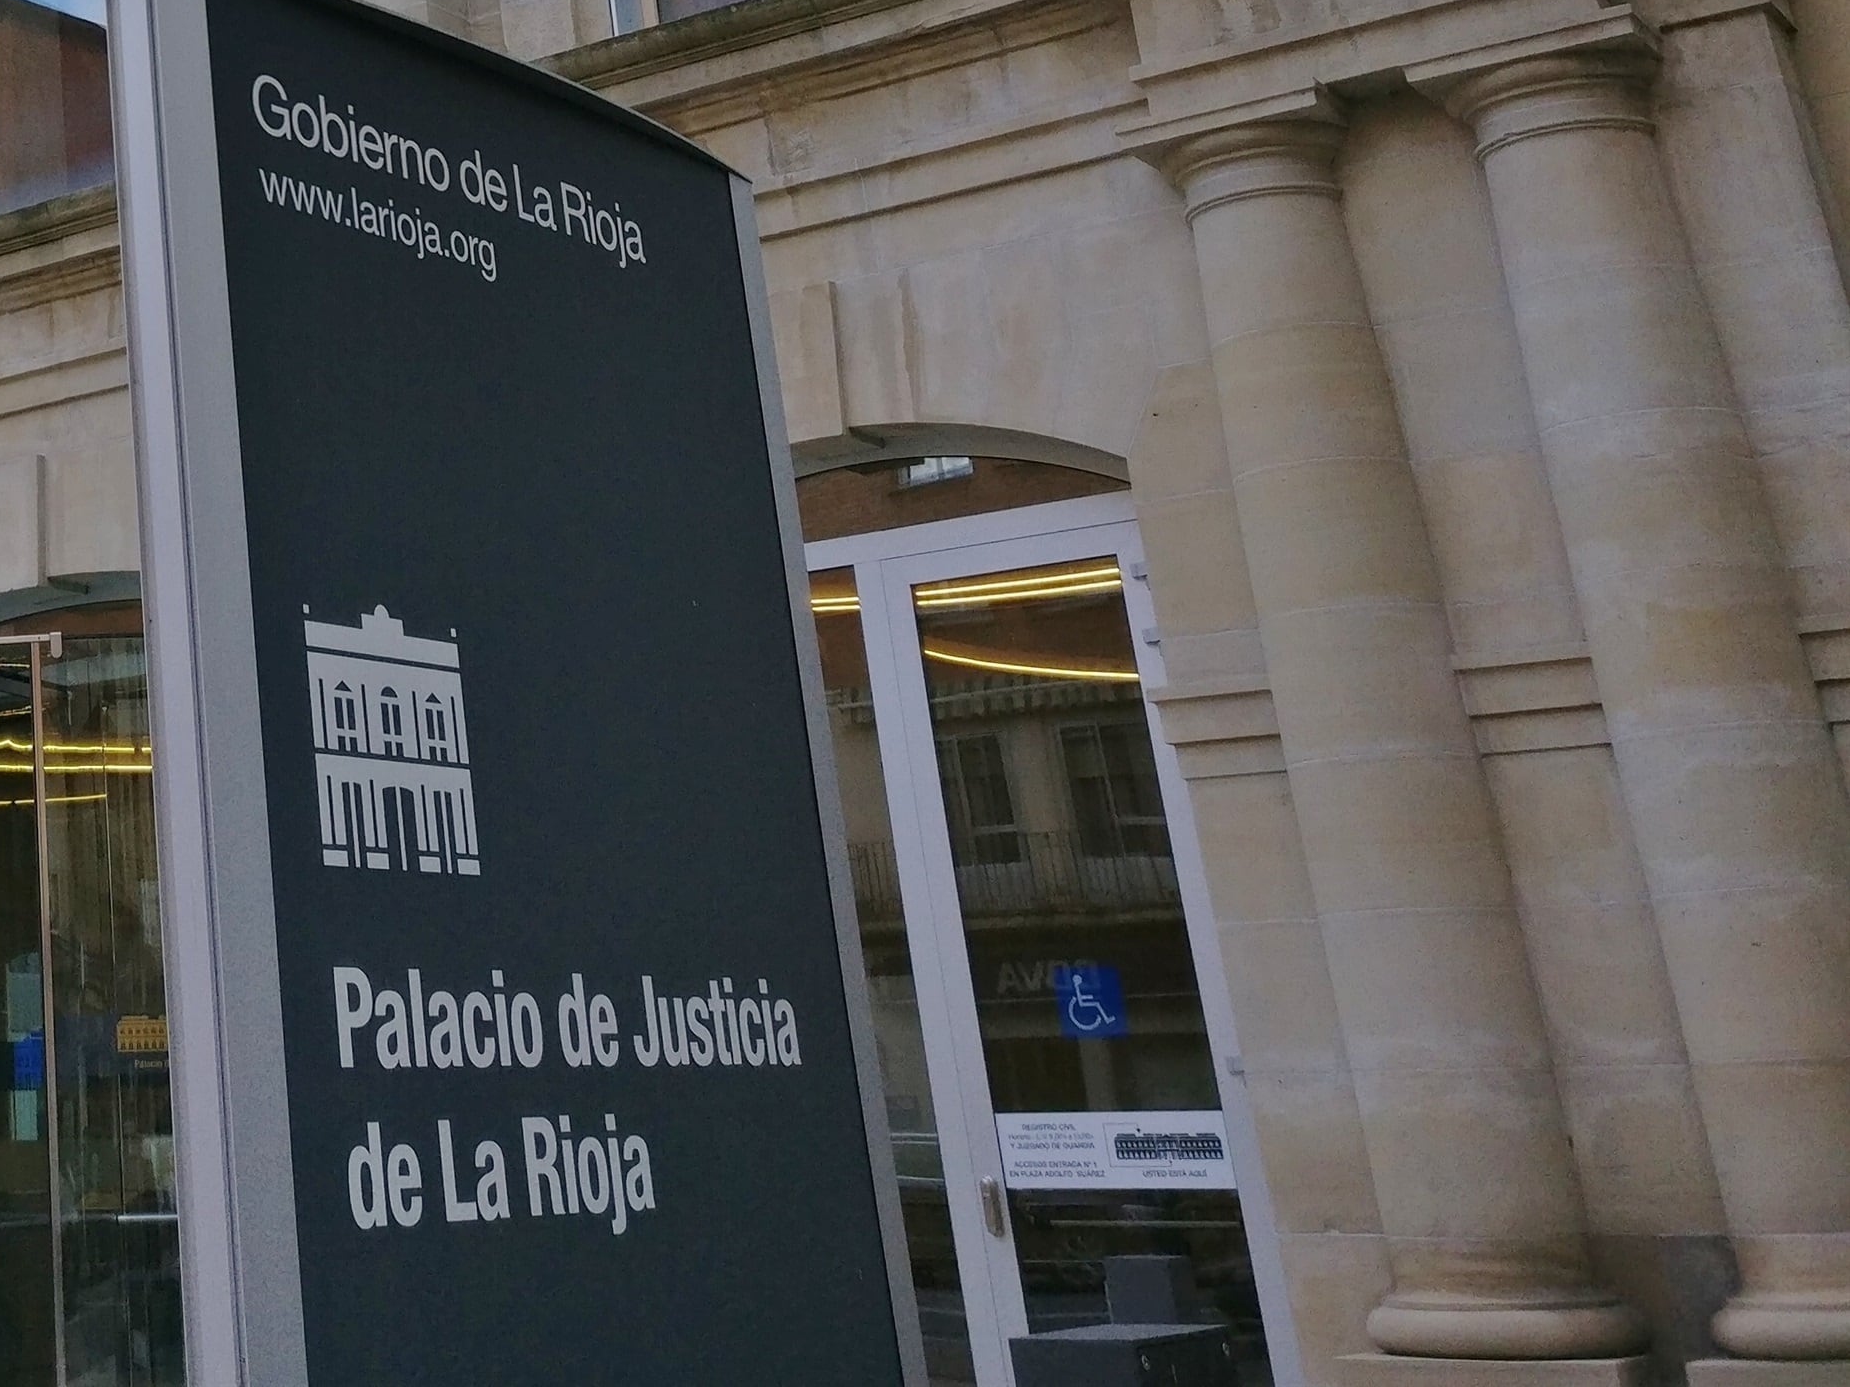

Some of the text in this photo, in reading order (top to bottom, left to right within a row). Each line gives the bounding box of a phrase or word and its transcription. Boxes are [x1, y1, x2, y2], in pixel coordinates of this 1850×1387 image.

[252, 74, 646, 269] Gobierno de La Rioja
[258, 167, 497, 282] www.larioja.org
[332, 966, 802, 1069] Palacio de Justicia
[347, 1113, 656, 1235] de La Rioja
